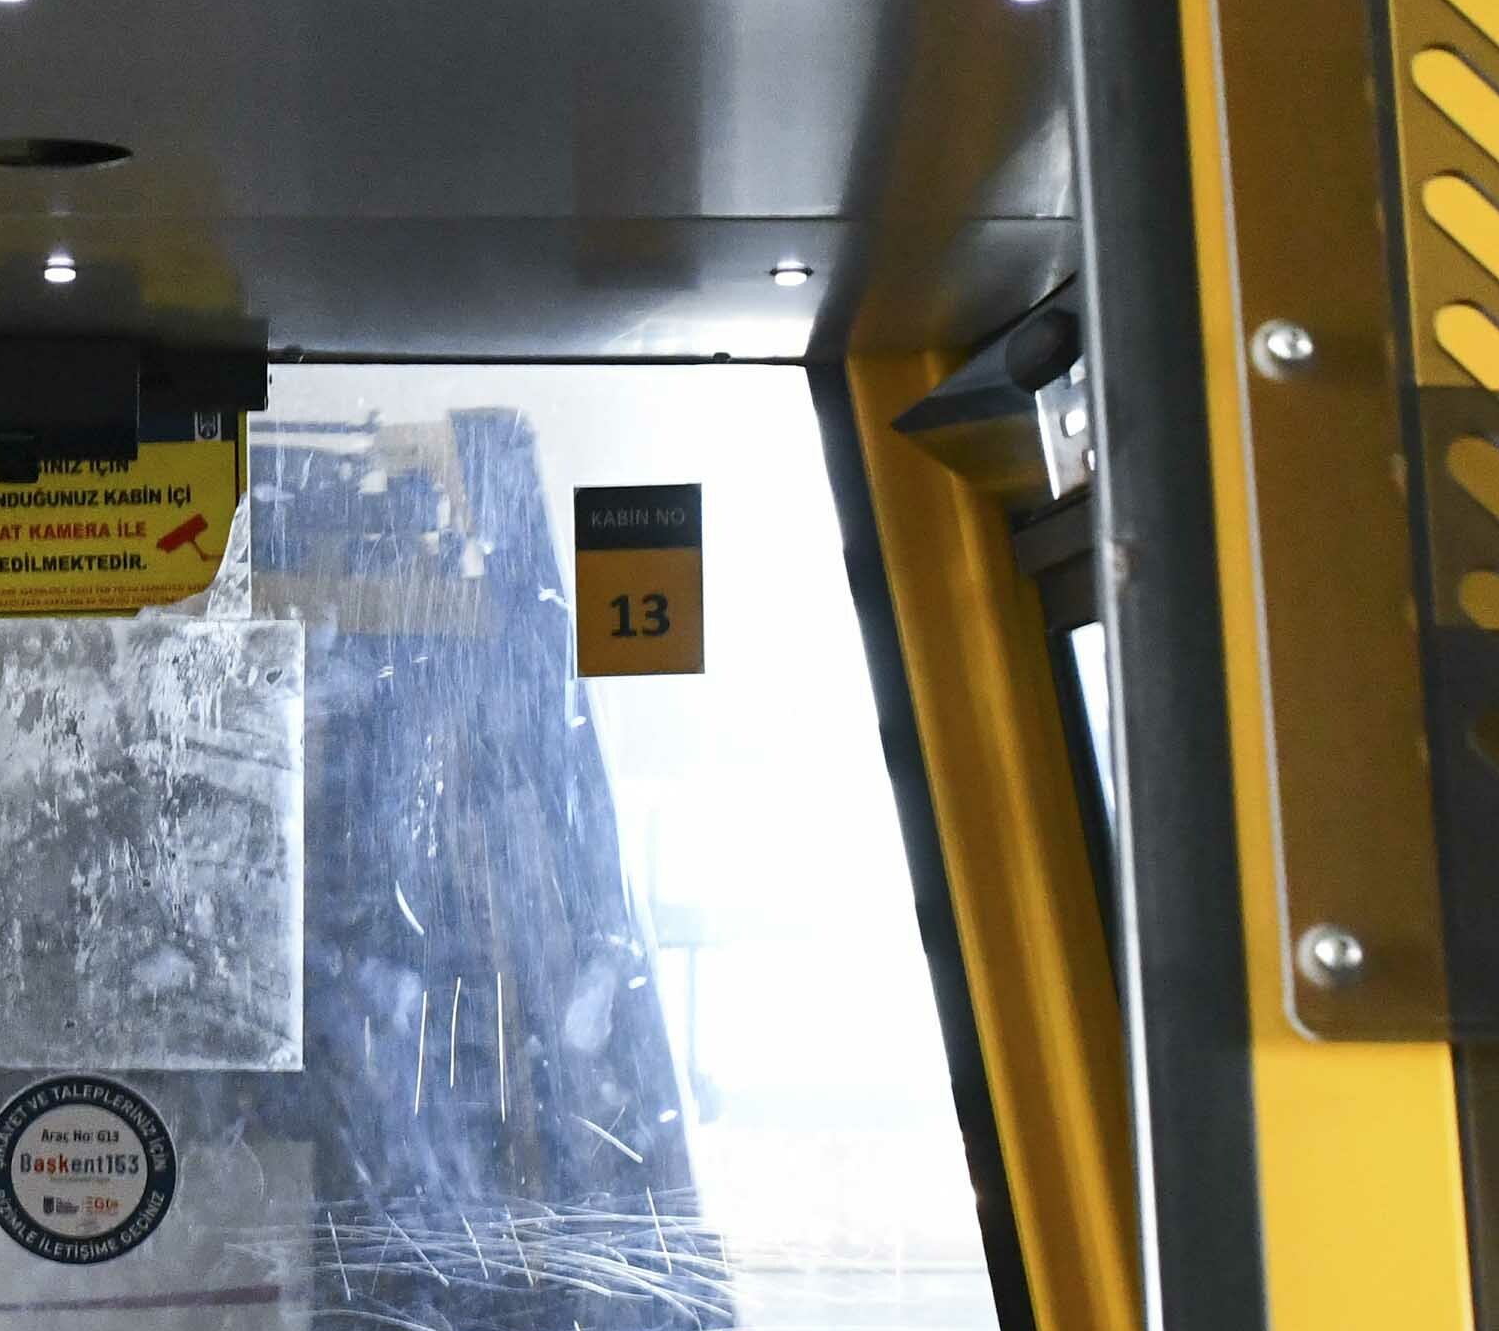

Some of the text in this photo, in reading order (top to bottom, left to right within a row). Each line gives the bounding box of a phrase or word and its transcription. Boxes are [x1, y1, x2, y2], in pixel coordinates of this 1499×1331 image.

[103, 484, 162, 507] KABİN
[167, 483, 191, 509] İÇİ
[656, 507, 685, 525] NO
[28, 520, 110, 541] KAMERA
[117, 519, 147, 539] İLE
[610, 593, 671, 638] 13
[29, 1092, 50, 1110] VE
[41, 1128, 69, 1144] Araç
[19, 1152, 140, 1176] Başkent153
[39, 1238, 119, 1261] İLETİŞİME
